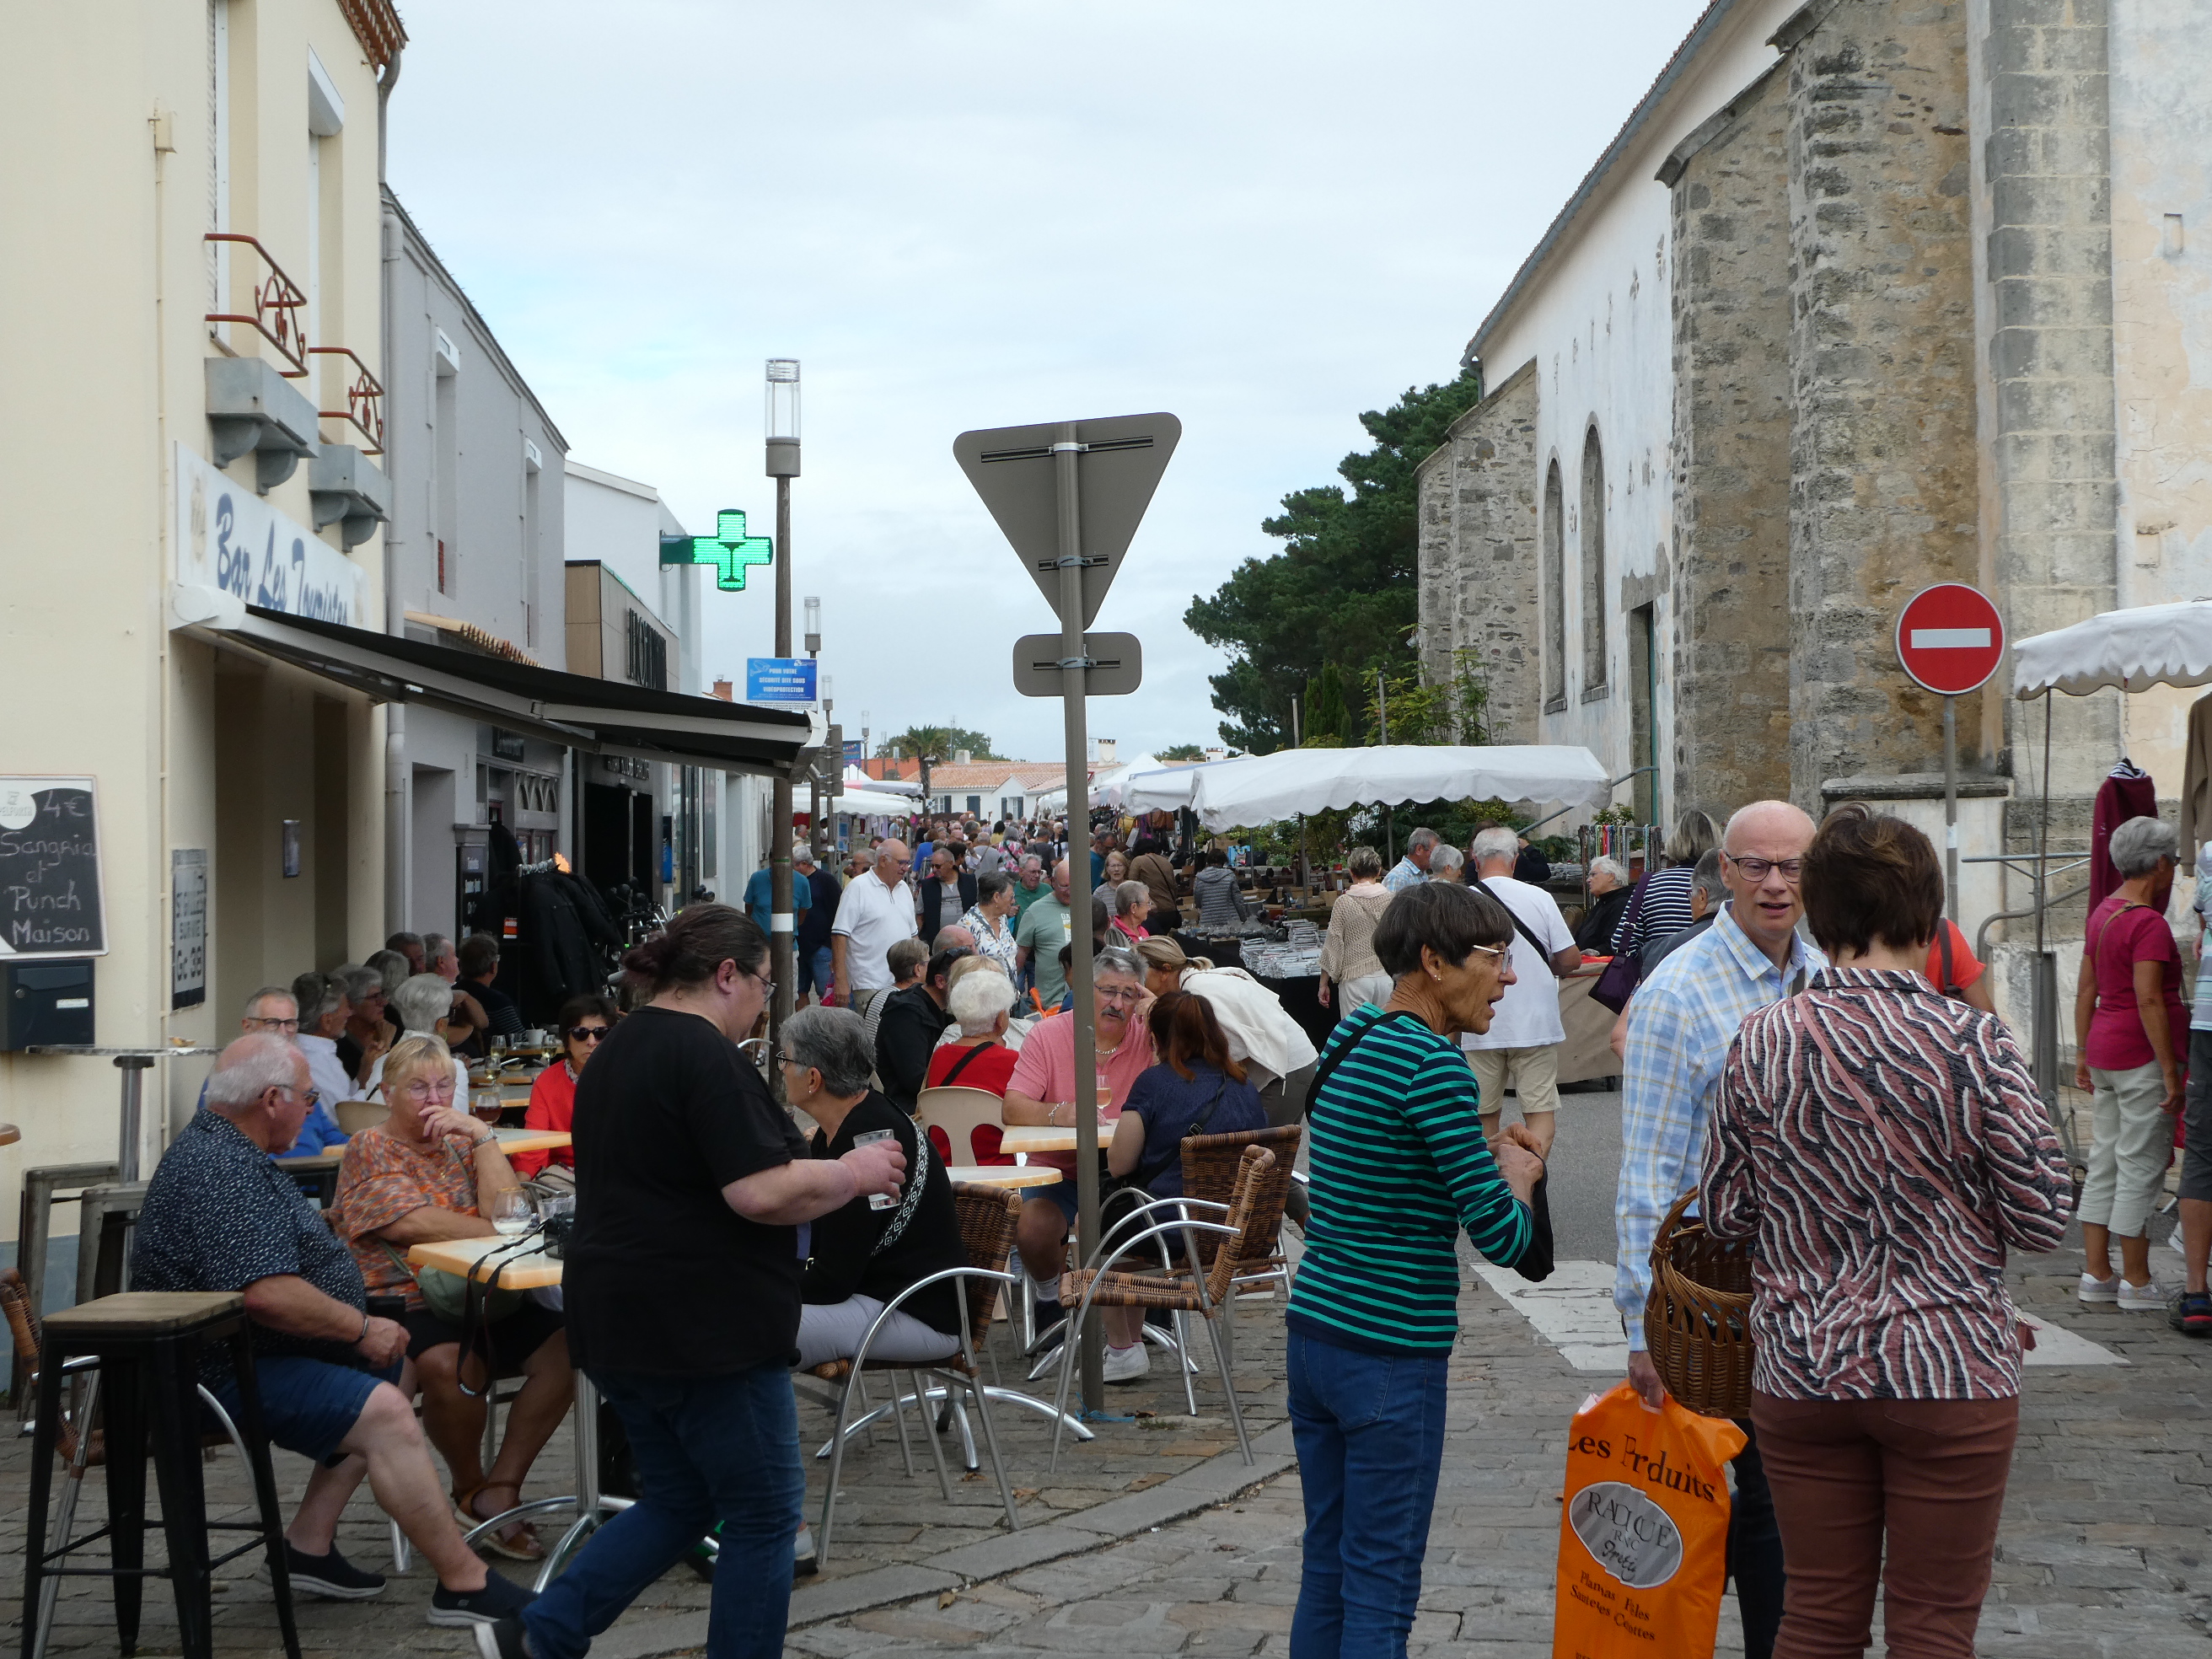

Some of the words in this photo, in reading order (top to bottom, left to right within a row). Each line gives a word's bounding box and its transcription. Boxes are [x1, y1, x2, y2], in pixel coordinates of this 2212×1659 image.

[216, 492, 252, 602] Bar
[258, 519, 287, 612] Les
[0, 831, 96, 866] Sangria
[26, 860, 48, 883] et
[3, 878, 81, 911] Punch
[12, 917, 90, 945] Maison
